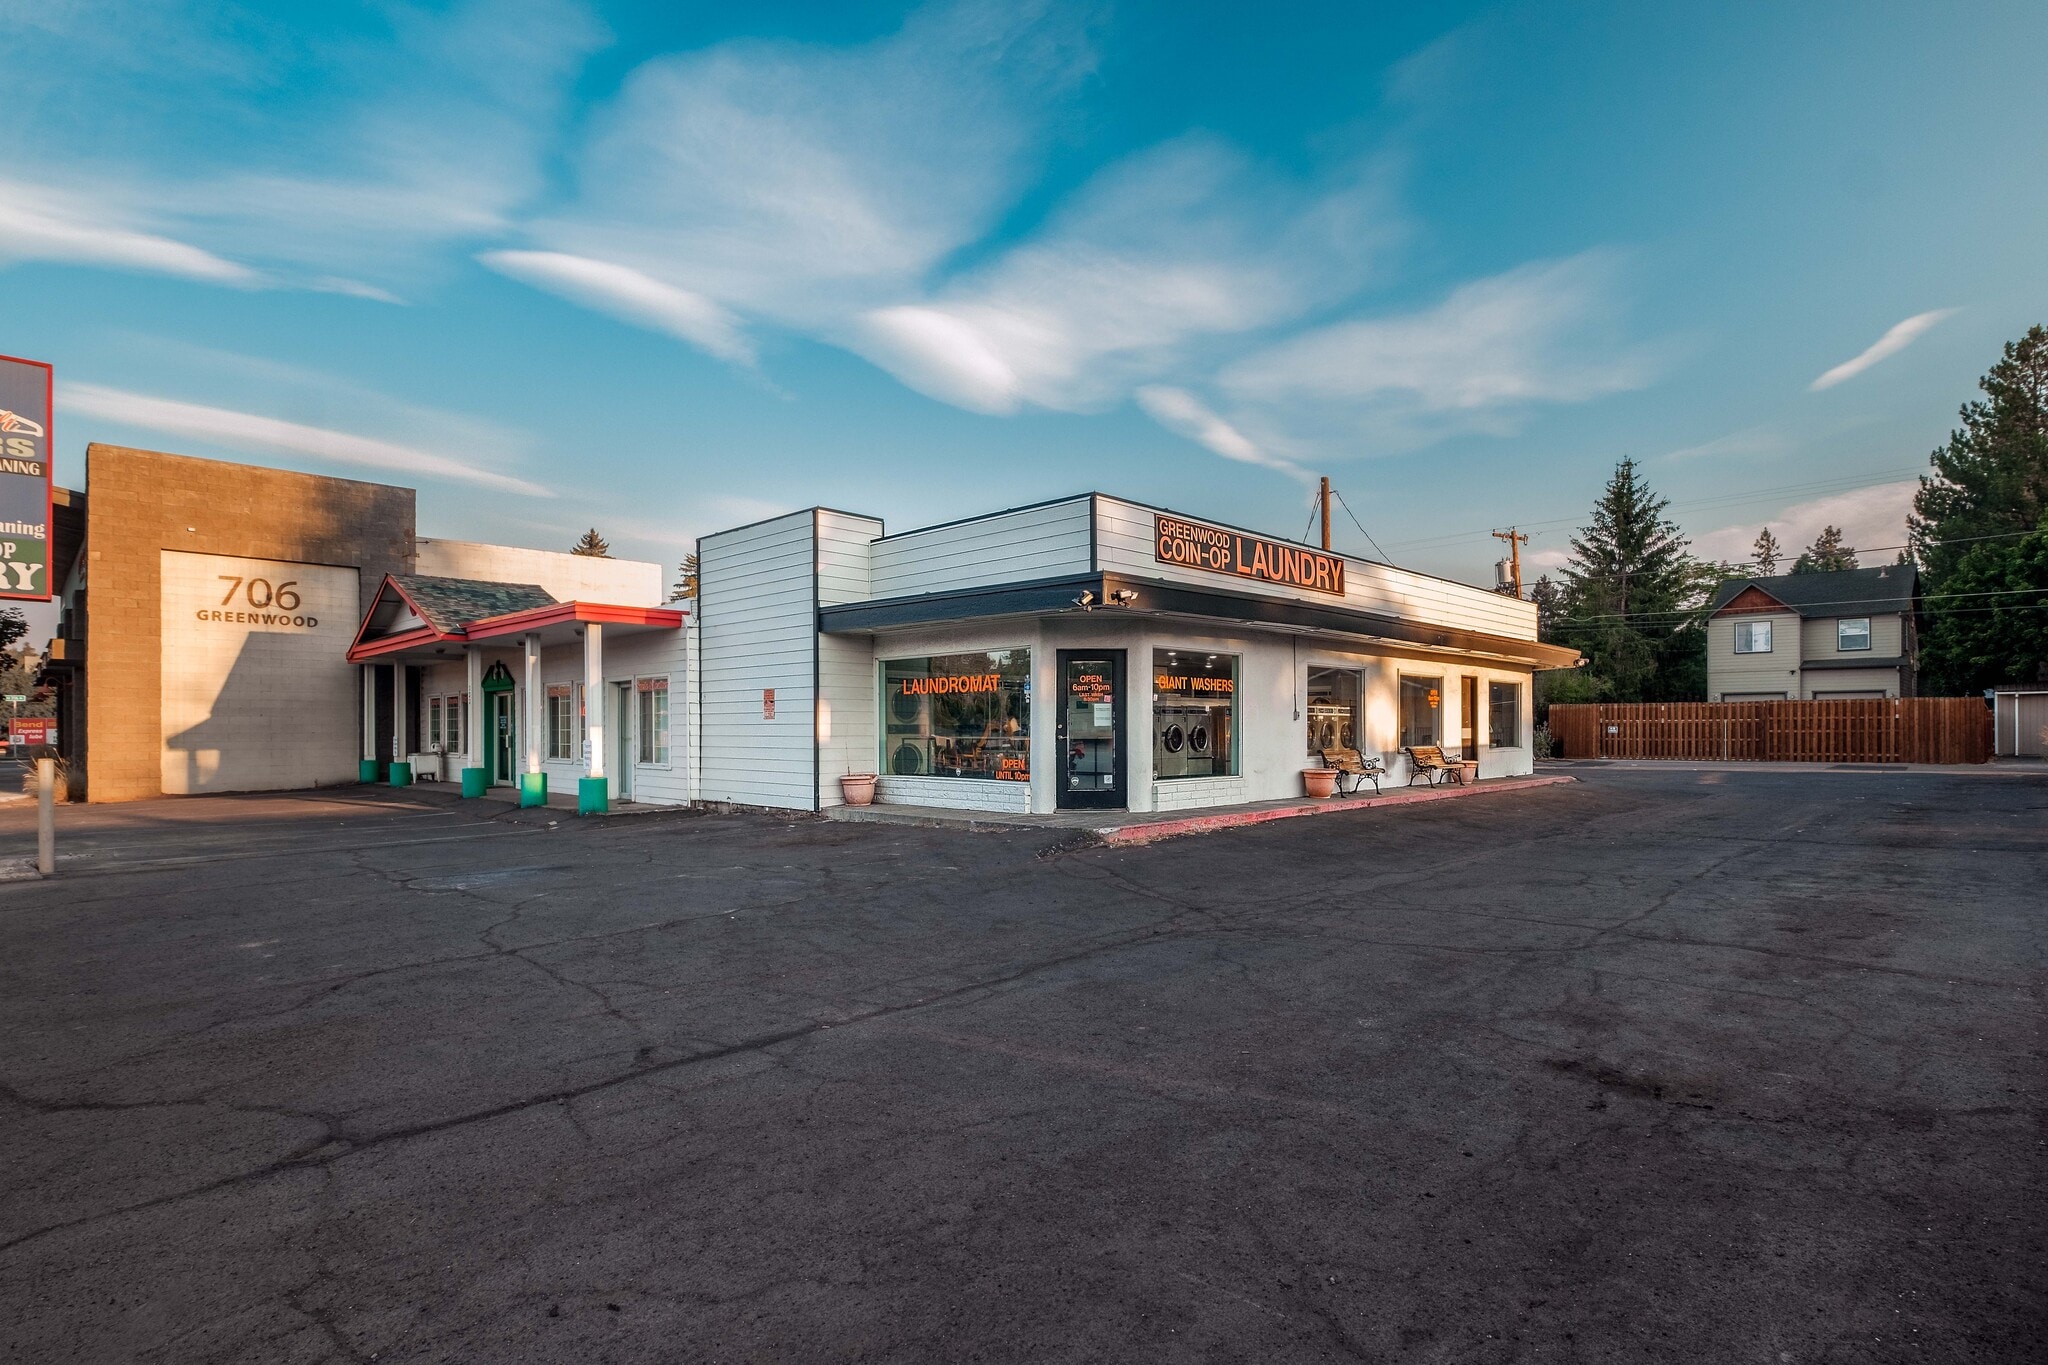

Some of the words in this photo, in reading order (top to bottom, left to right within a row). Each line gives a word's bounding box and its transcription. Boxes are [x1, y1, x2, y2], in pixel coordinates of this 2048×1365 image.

[0, 437, 35, 458] S
[0, 459, 41, 476] NING
[1159, 519, 1230, 549] GREENWOOD
[0, 542, 17, 559] P
[1159, 536, 1231, 570] COIN-OP
[1236, 537, 1342, 591] LAUNDRY
[218, 575, 301, 611] 706
[196, 609, 319, 628] GREENWOOD
[903, 674, 1001, 695] LAUNDROMAT
[1079, 675, 1103, 683] OPEN
[1158, 675, 1188, 690] GIANT
[1190, 677, 1234, 693] WASHERS
[1002, 758, 1025, 770] OPEN
[995, 771, 1013, 780] UNTIL
[1014, 771, 1031, 782] 10pm
